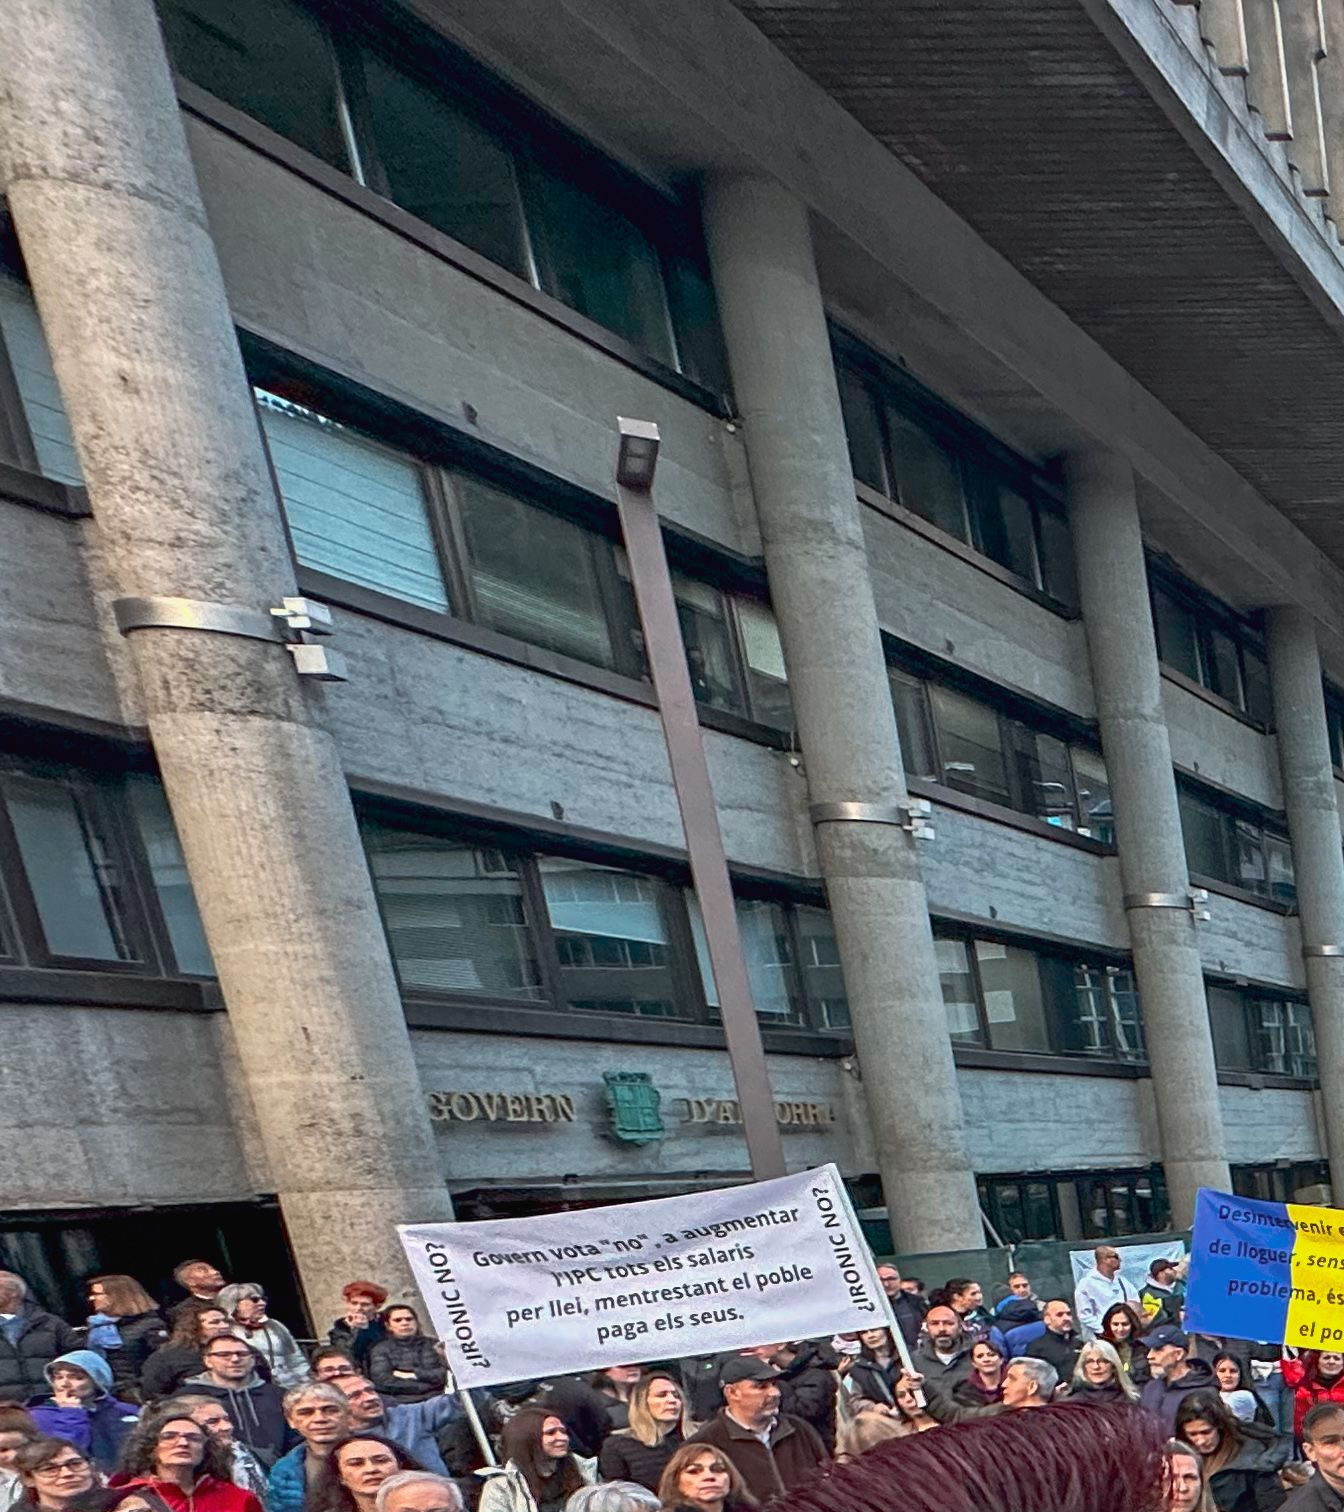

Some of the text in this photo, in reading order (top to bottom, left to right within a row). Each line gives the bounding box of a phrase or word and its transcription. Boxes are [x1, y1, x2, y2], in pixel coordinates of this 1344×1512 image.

[430, 1091, 834, 1125] GOVERN D'AORRA
[812, 1187, 841, 1229] NO?
[1218, 1204, 1332, 1235] Desintervenir
[473, 1248, 548, 1268] Govern
[549, 1244, 601, 1261] vota
[663, 1231, 679, 1244] a
[681, 1207, 799, 1239] augmentar
[1209, 1237, 1232, 1256] de
[1236, 1242, 1300, 1269] lloguer,
[424, 1242, 456, 1284] NO?
[607, 1261, 650, 1280] tots
[654, 1253, 683, 1273] els
[687, 1243, 755, 1268] salaris
[506, 1264, 813, 1327] per llei, mentrestant el poble
[1228, 1278, 1321, 1307] problema,
[597, 1306, 745, 1344] paga els seus.
[1299, 1321, 1316, 1338] el
